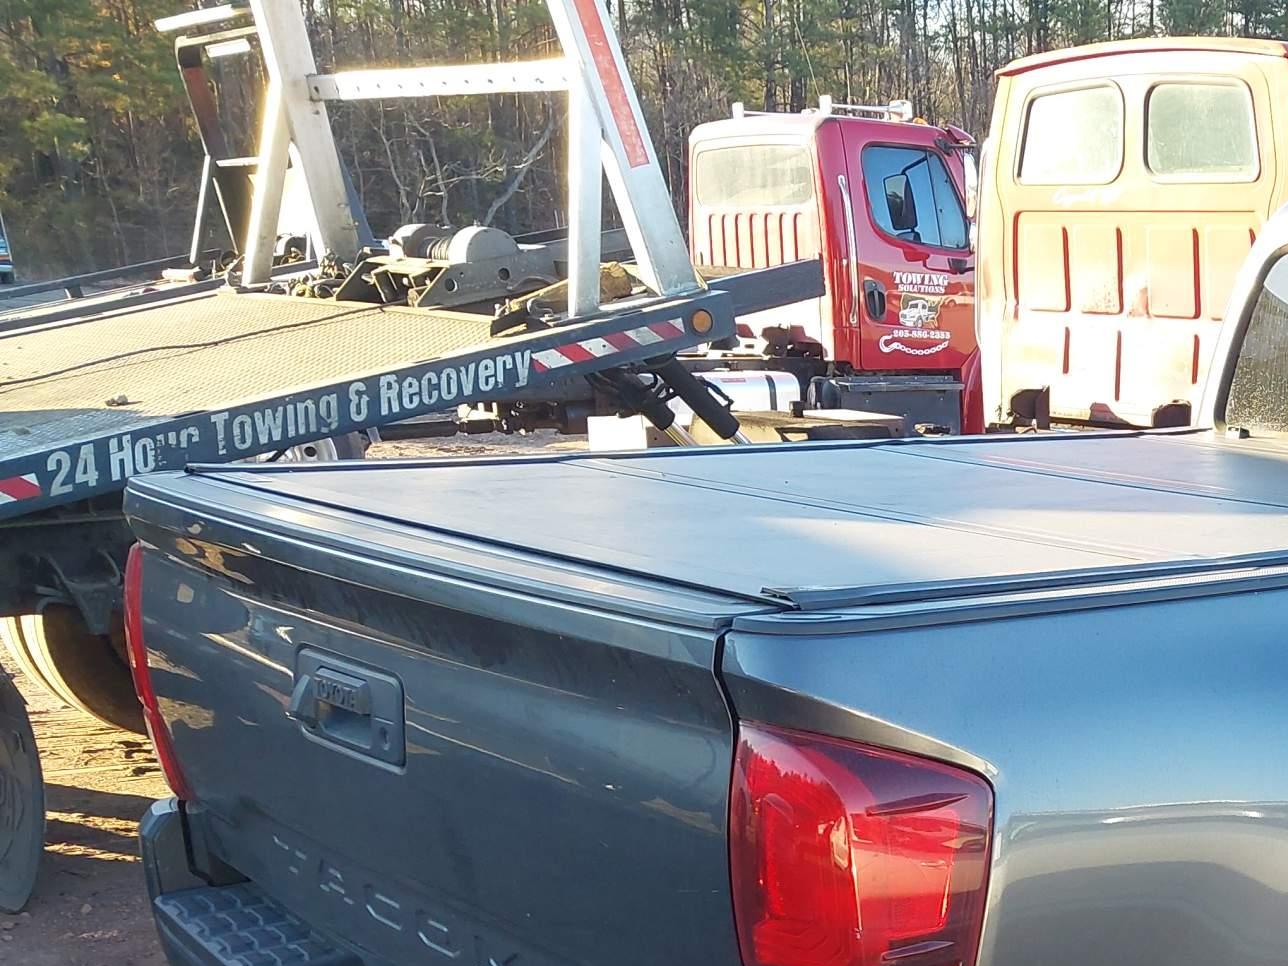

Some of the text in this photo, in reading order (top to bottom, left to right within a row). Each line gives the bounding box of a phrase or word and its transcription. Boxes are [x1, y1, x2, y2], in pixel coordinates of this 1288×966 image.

[893, 271, 949, 286] TOWING
[897, 283, 946, 294] SOLUTIONS
[47, 443, 99, 497] 24
[211, 393, 339, 456] Towing
[349, 381, 370, 422] &
[379, 349, 531, 416] Recovery
